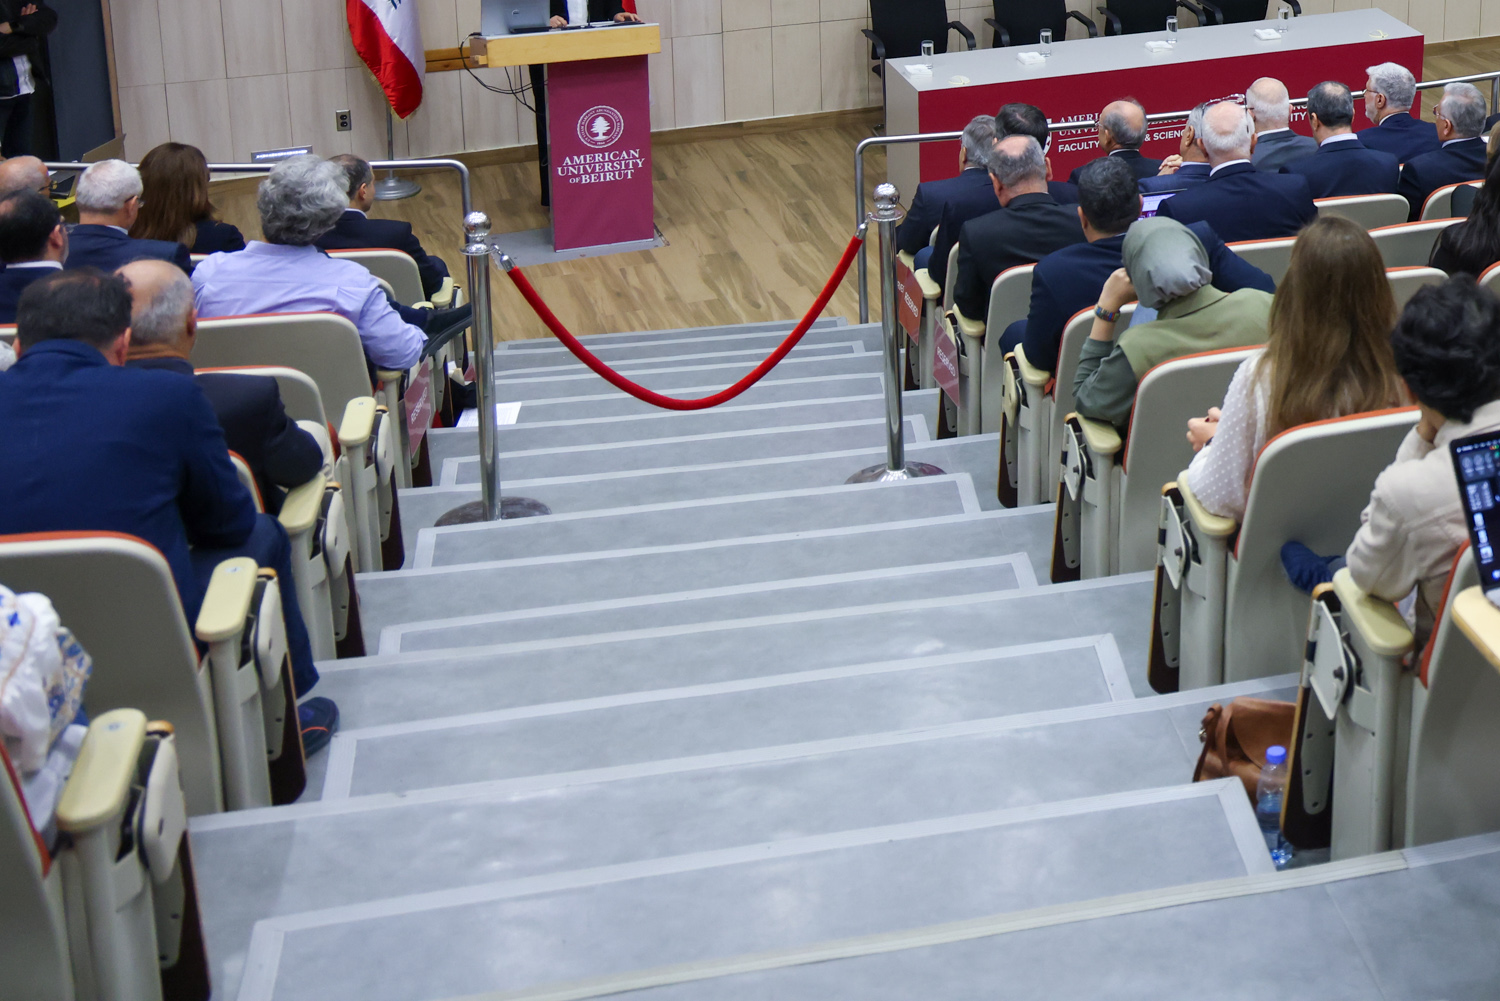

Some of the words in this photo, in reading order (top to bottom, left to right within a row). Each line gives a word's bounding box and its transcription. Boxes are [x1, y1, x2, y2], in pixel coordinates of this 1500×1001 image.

[1060, 112, 1099, 123] AMERI
[1144, 133, 1151, 142] &
[1058, 140, 1100, 153] FACULTY
[562, 148, 640, 166] AMERICAN
[557, 158, 645, 176] UNIVERSITY
[580, 169, 634, 184] BEIRUT
